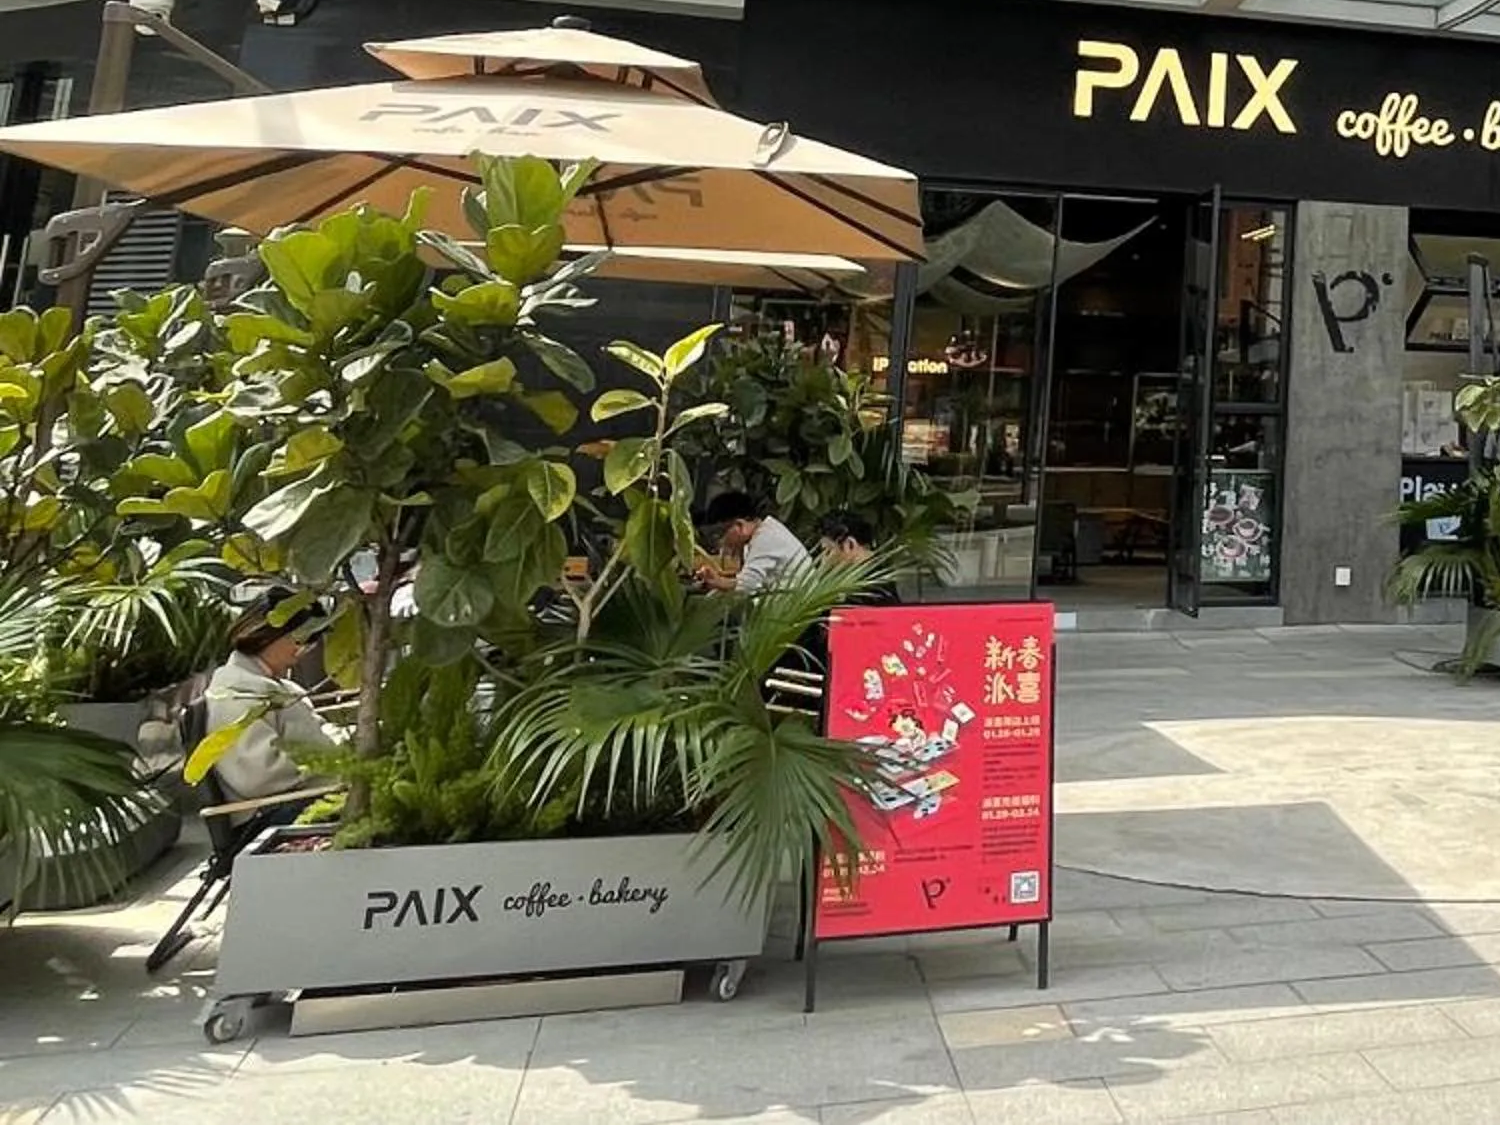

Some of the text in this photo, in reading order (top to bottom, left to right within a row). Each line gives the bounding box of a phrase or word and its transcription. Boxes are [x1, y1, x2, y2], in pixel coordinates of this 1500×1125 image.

[358, 102, 625, 133] PAIX
[1073, 39, 1299, 134] PAIX
[1336, 92, 1455, 158] coffee
[363, 876, 669, 930] PAIX coffee bakery
